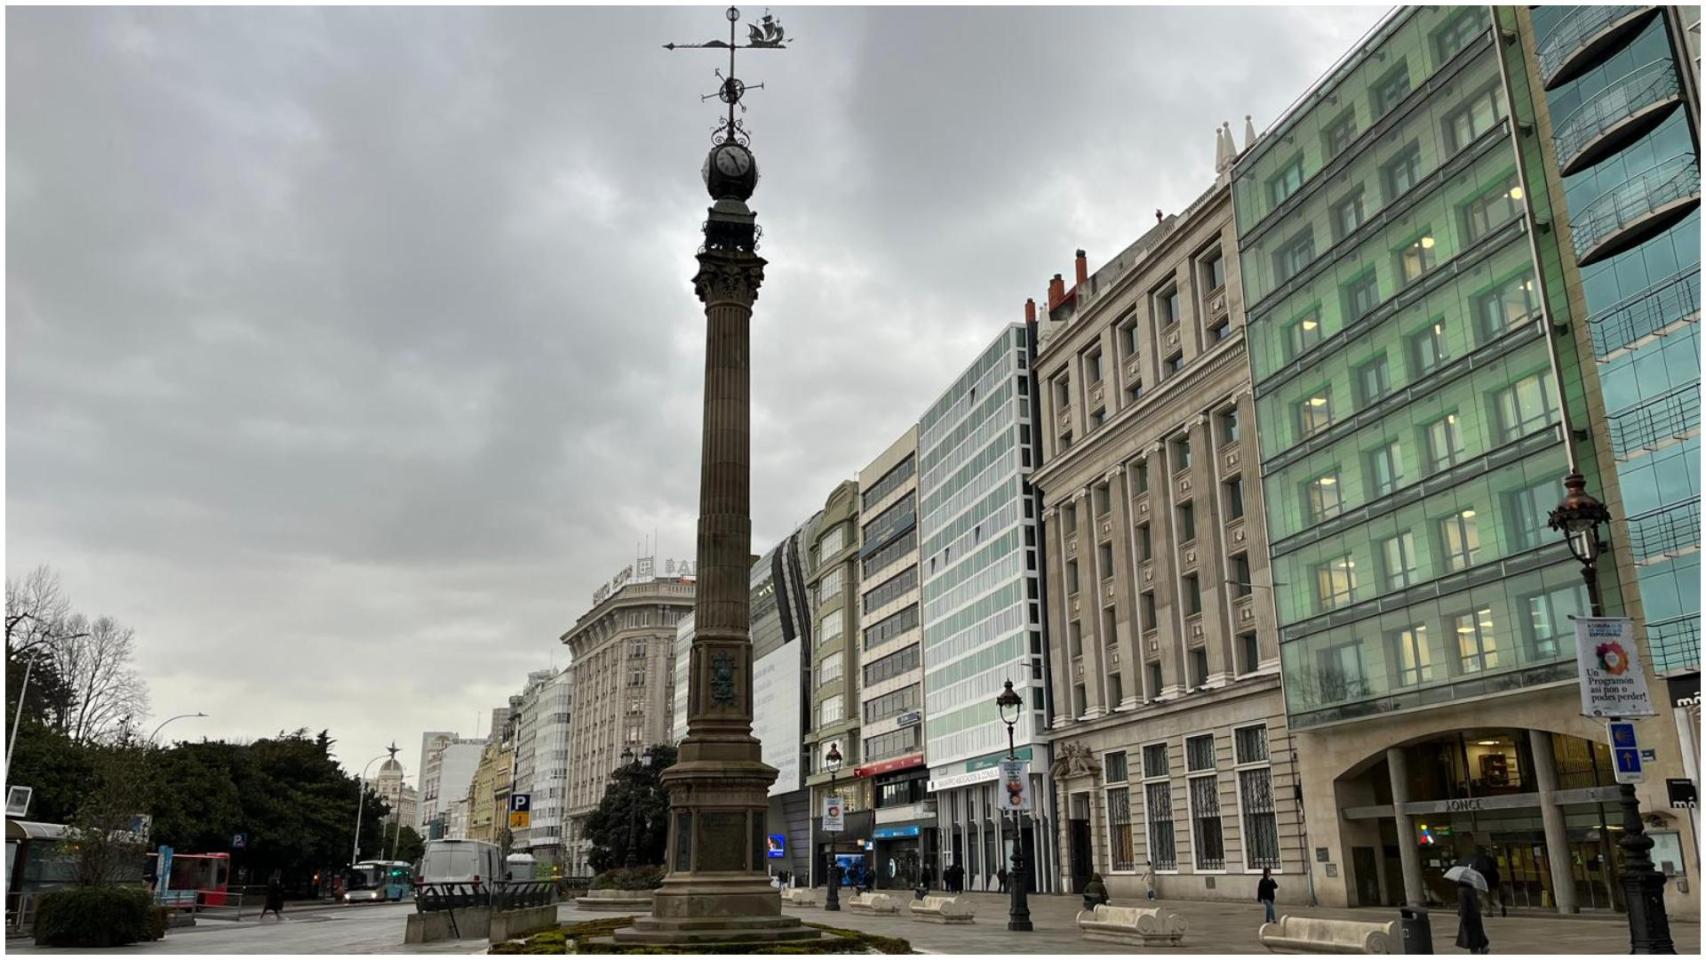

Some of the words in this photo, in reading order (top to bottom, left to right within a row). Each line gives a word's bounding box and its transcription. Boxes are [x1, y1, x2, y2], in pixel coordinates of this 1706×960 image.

[1586, 668, 1600, 677] Un
[515, 796, 526, 810] P
[1451, 798, 1484, 811] ONCE
